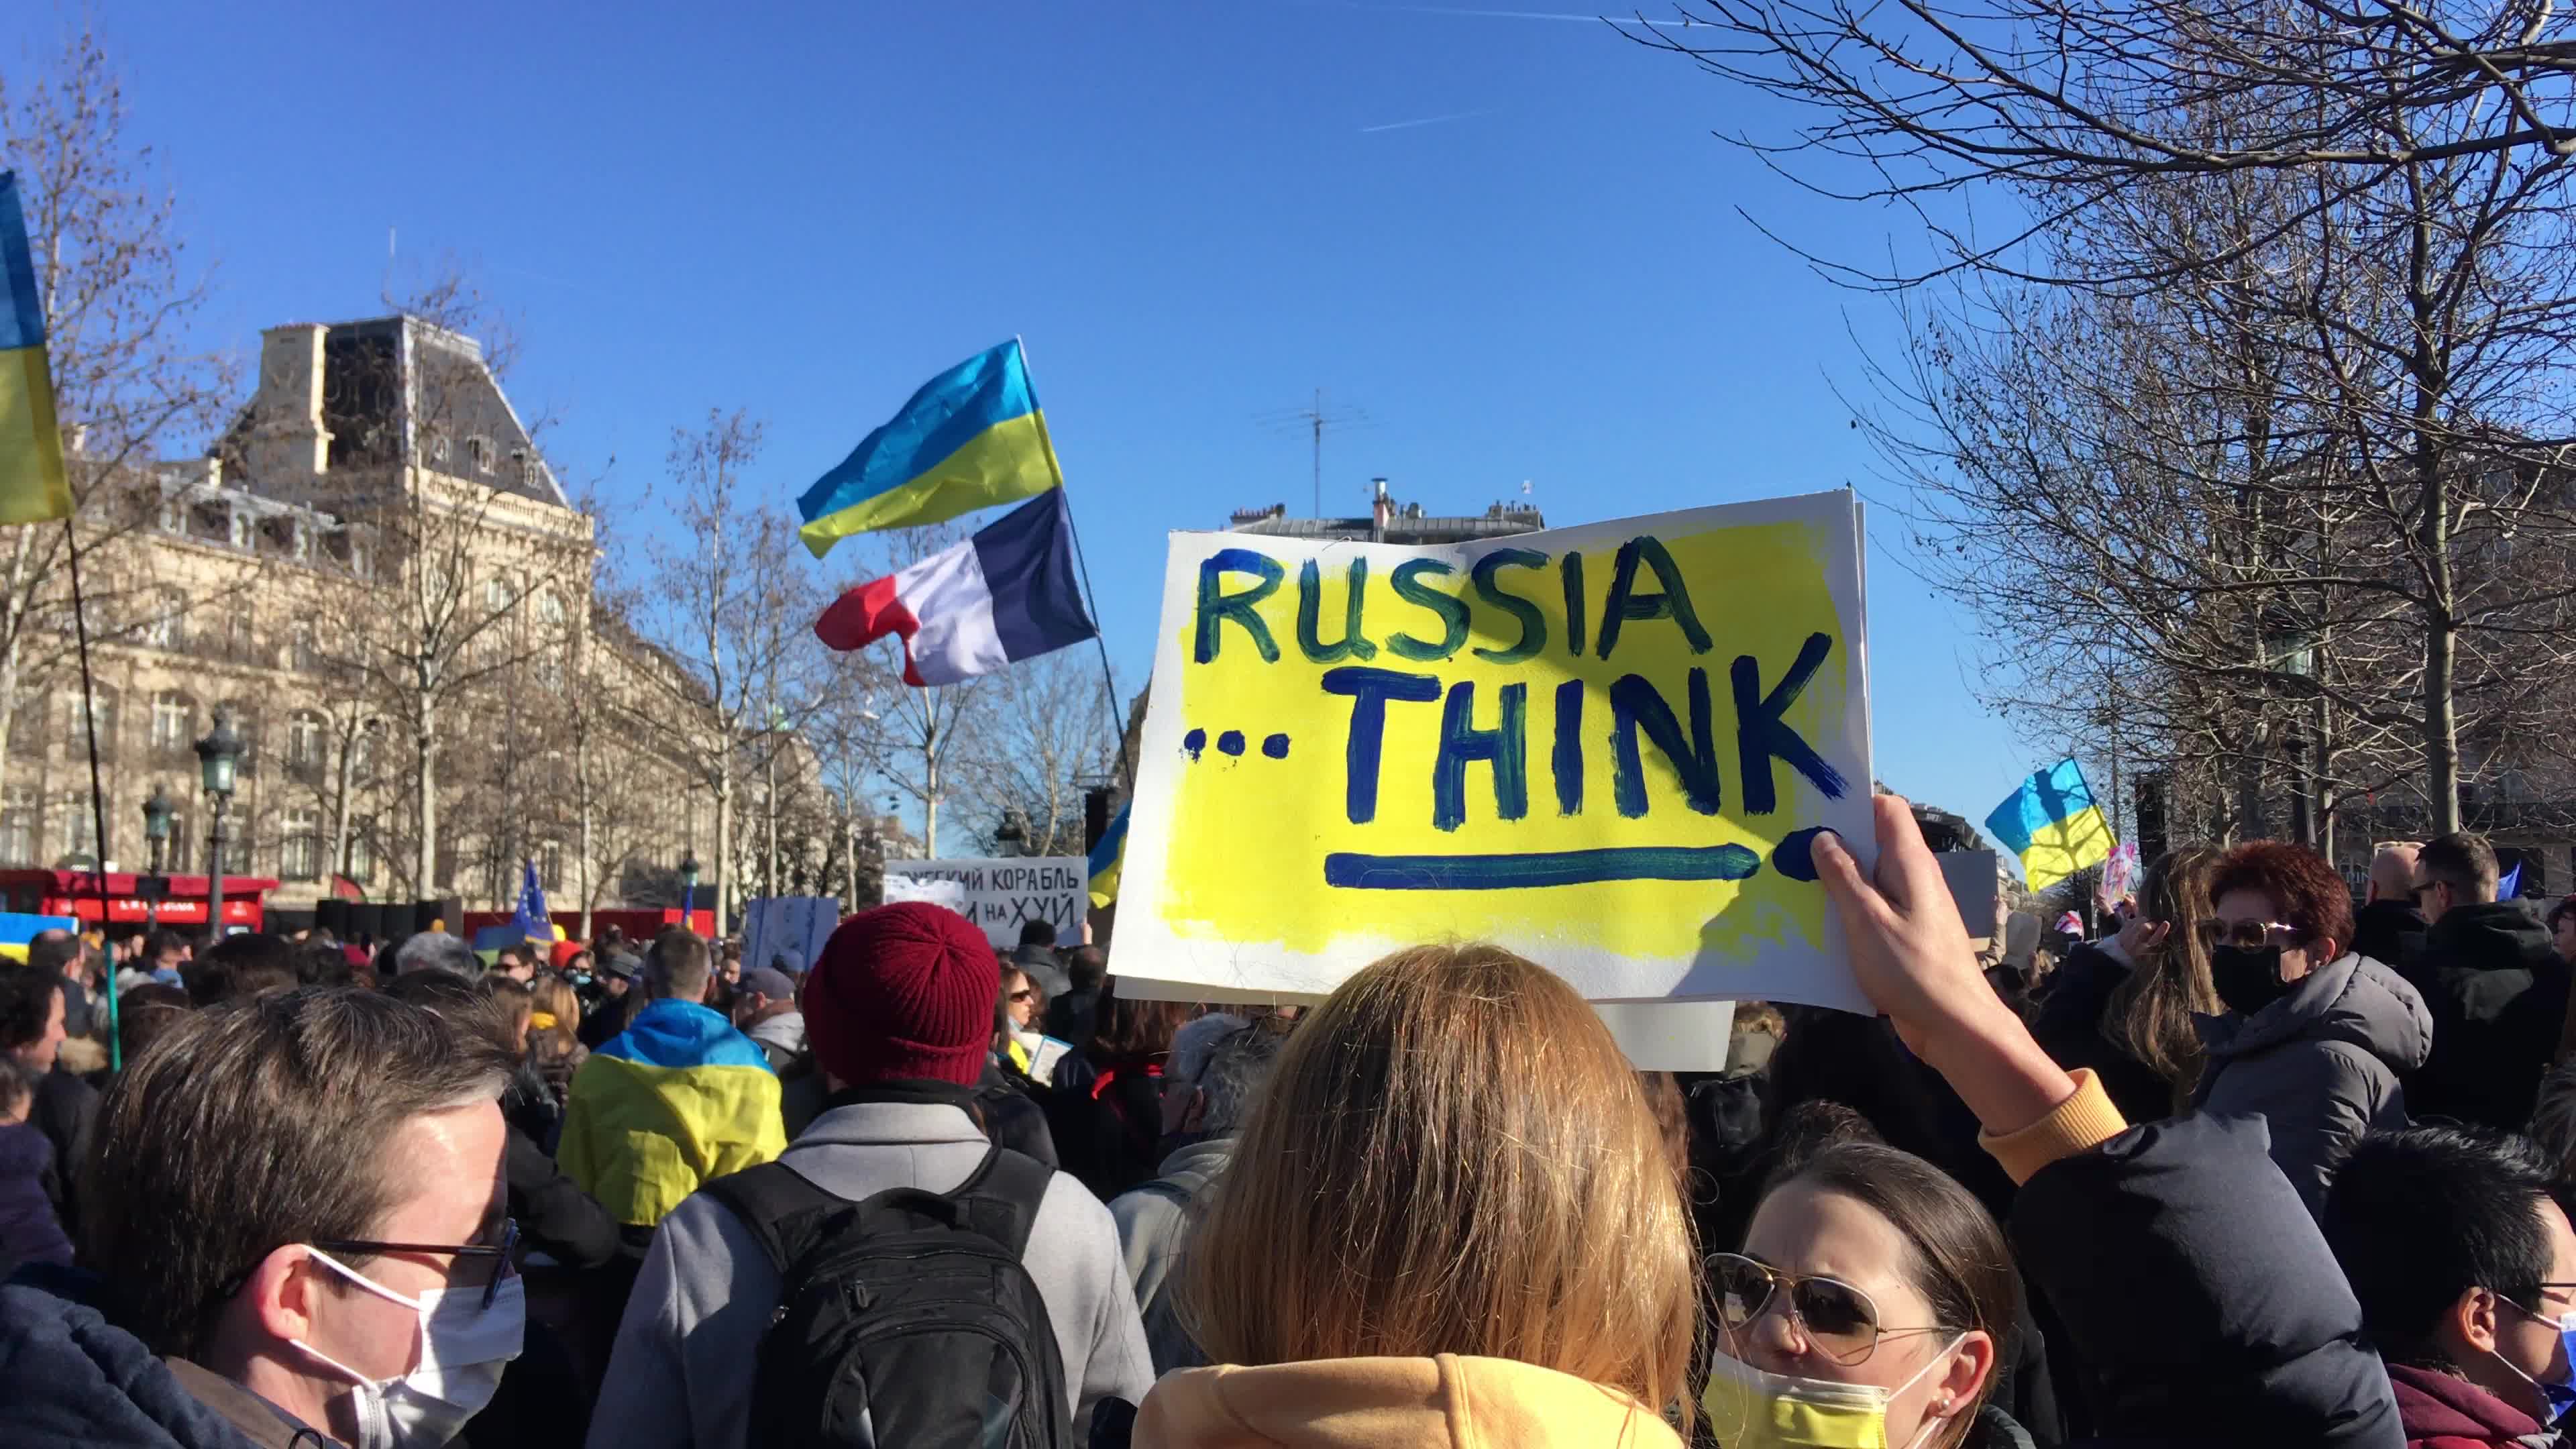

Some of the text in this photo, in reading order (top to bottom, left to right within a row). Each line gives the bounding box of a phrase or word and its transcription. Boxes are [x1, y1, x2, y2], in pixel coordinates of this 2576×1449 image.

[1194, 536, 1713, 663] RUSSIA
[899, 867, 1079, 891] УКИЙ КОРАБЛЬ
[1009, 893, 1074, 928] ХУЙ
